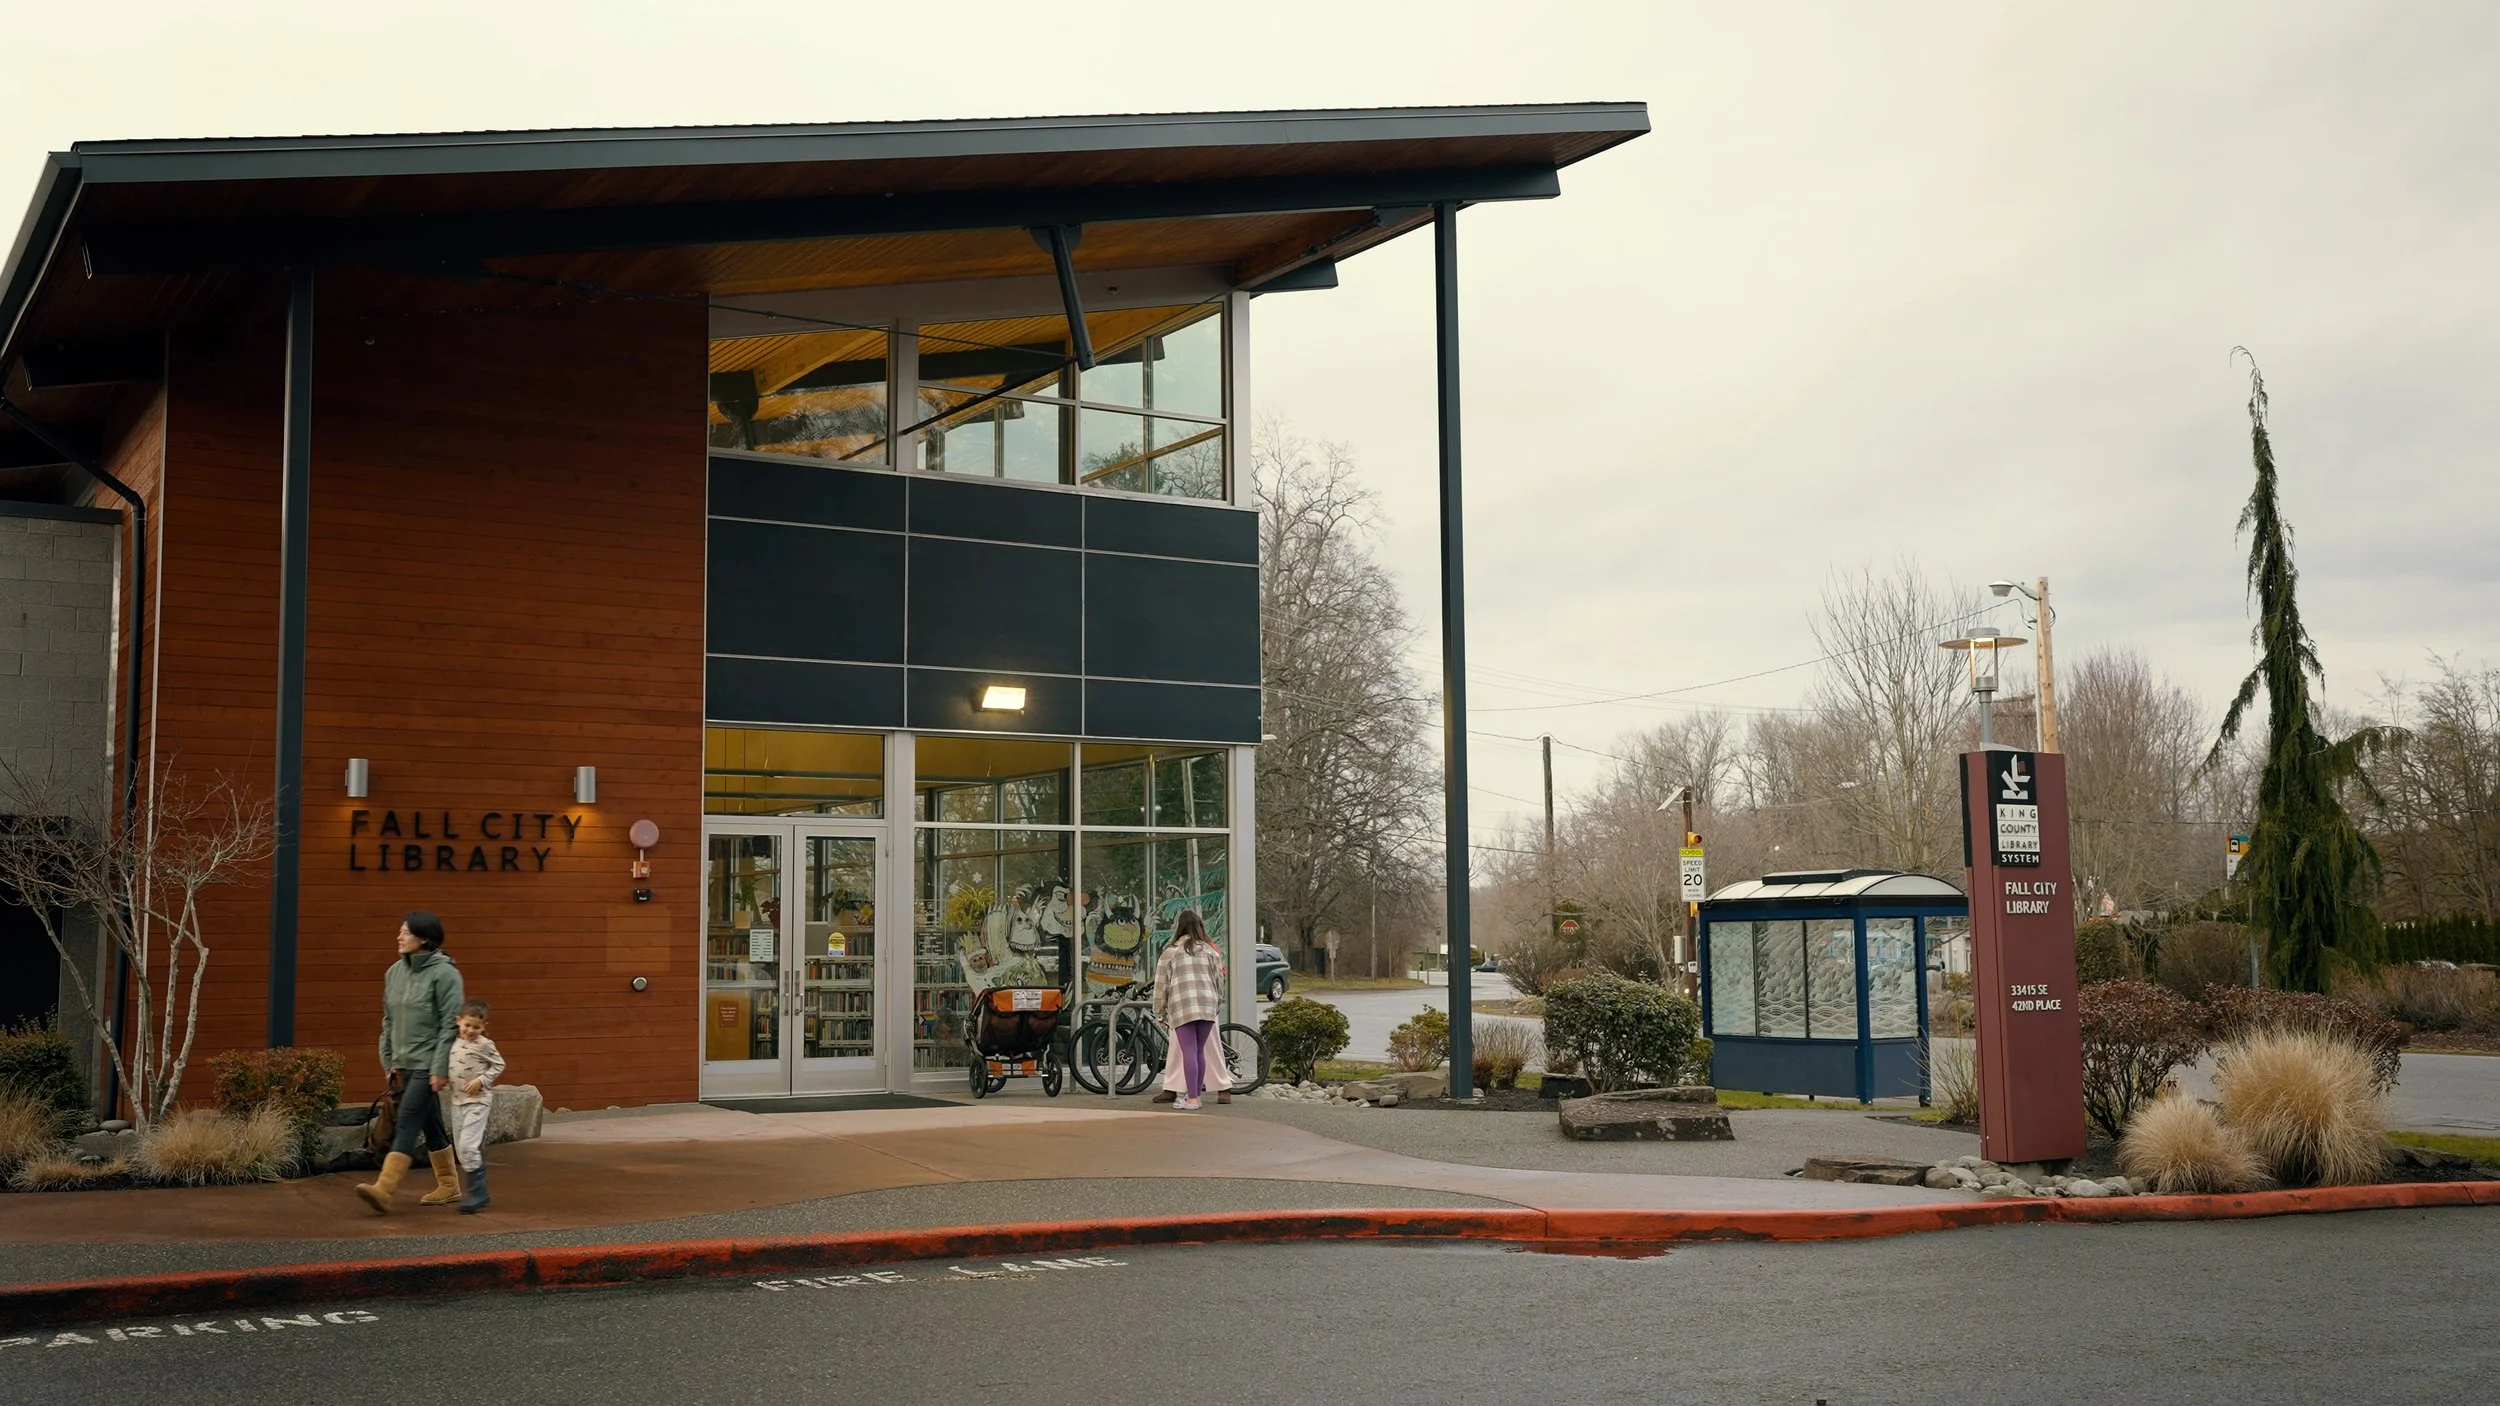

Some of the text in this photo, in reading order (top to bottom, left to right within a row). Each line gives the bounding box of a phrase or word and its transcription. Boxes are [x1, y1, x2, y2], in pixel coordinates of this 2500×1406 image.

[1999, 808, 2037, 819] KING
[351, 809, 582, 840] FALL CITY
[2000, 824, 2037, 834] COUNTY
[2001, 840, 2038, 849] LIBRARY
[350, 844, 551, 872] LIBRARY
[2001, 854, 2040, 863] SYSTEM
[1684, 874, 1702, 886] 20
[2005, 881, 2057, 895] FALL CITY
[2006, 900, 2050, 914] LIBRARY
[2011, 984, 2048, 996] 33415 SE
[2012, 999, 2062, 1011] 42ND PLACE
[752, 1257, 1130, 1291] FIRE LANE
